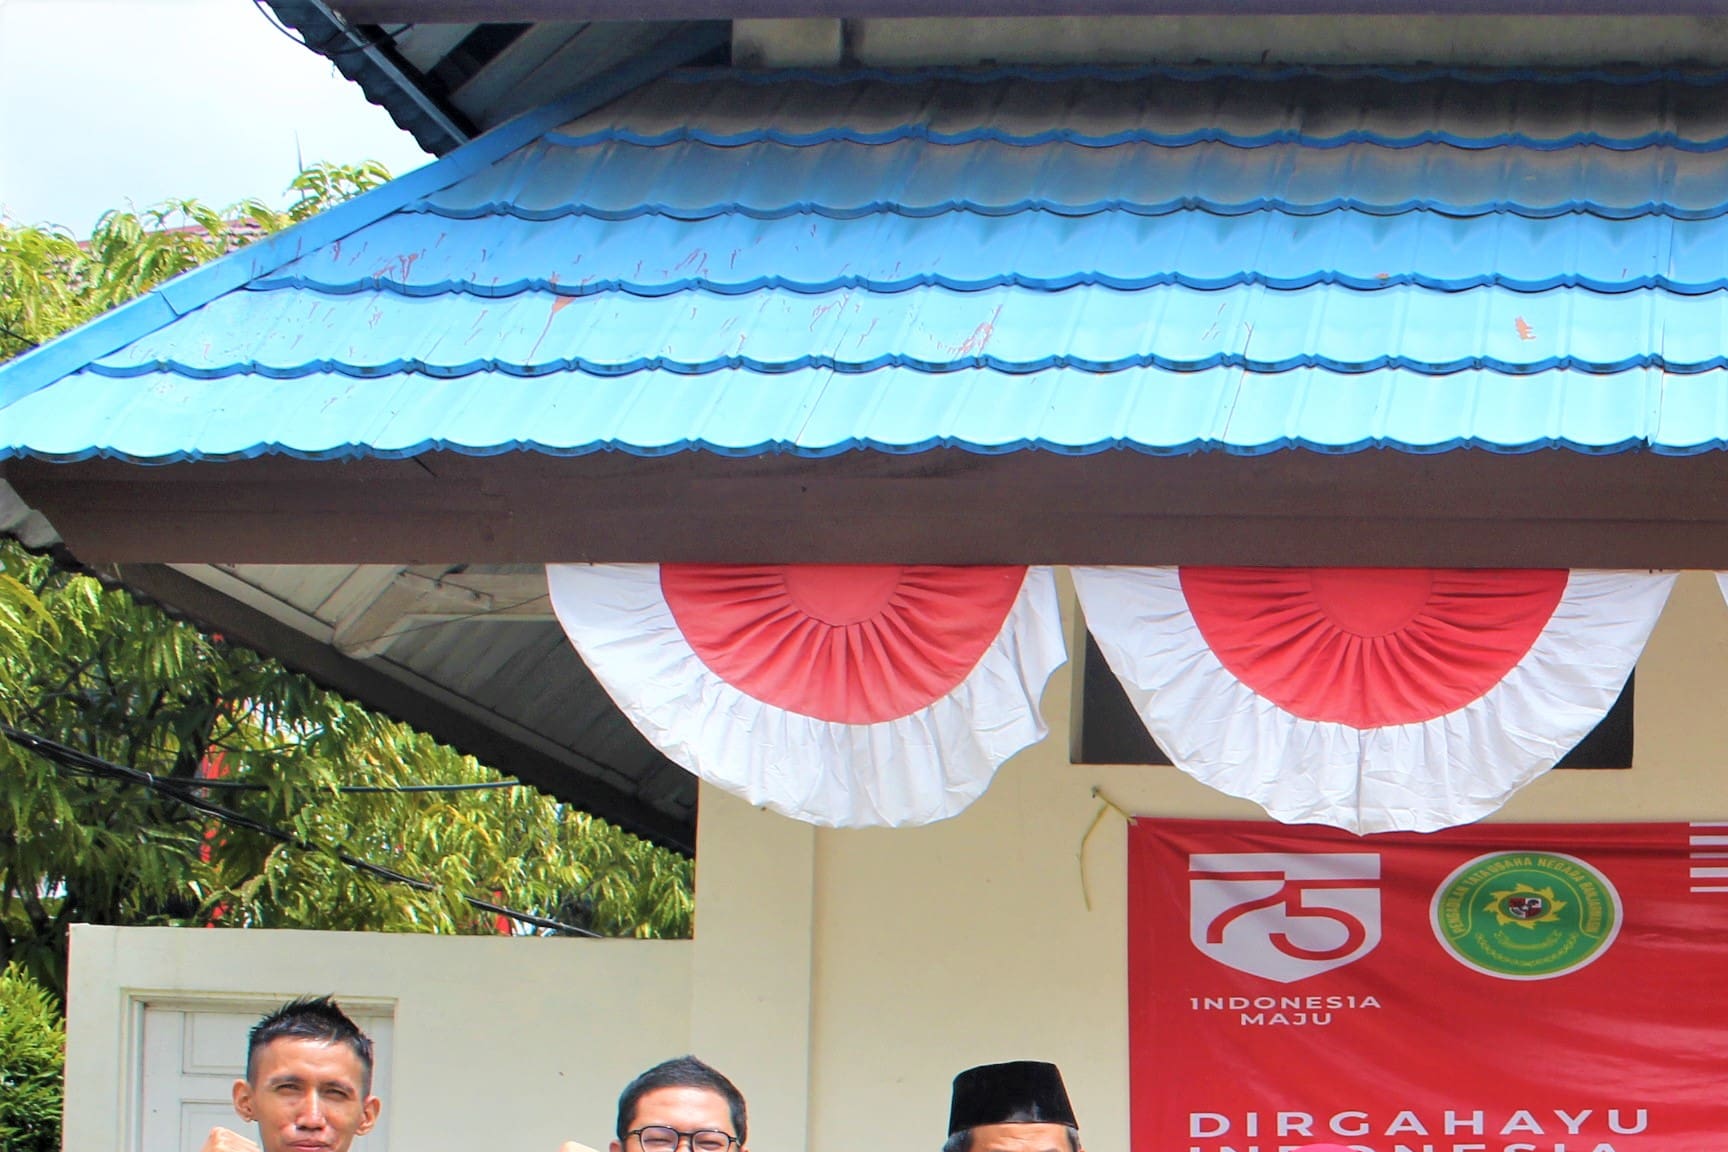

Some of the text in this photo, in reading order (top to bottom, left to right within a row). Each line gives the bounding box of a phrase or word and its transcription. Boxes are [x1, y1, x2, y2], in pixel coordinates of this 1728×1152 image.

[1190, 995, 1381, 1010] INDONESIA
[1240, 1012, 1332, 1026] MAJU
[1189, 1109, 1648, 1138] DIRGAHAYU
